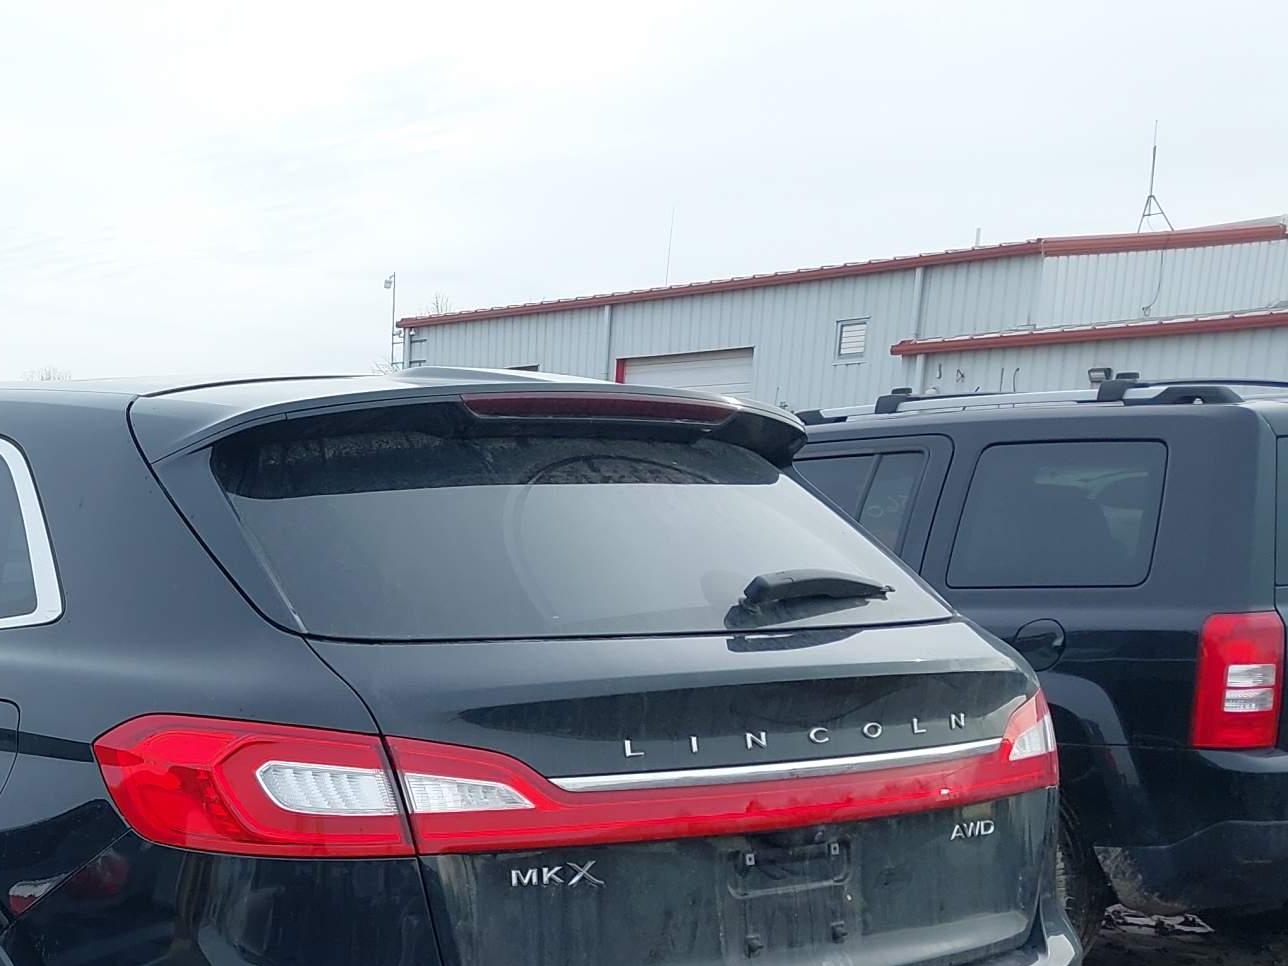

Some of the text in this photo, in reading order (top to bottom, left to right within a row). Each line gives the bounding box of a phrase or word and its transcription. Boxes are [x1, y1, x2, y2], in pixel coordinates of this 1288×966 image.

[622, 711, 967, 759] LINCOLN
[950, 819, 995, 841] AWD
[511, 860, 605, 887] MKX
